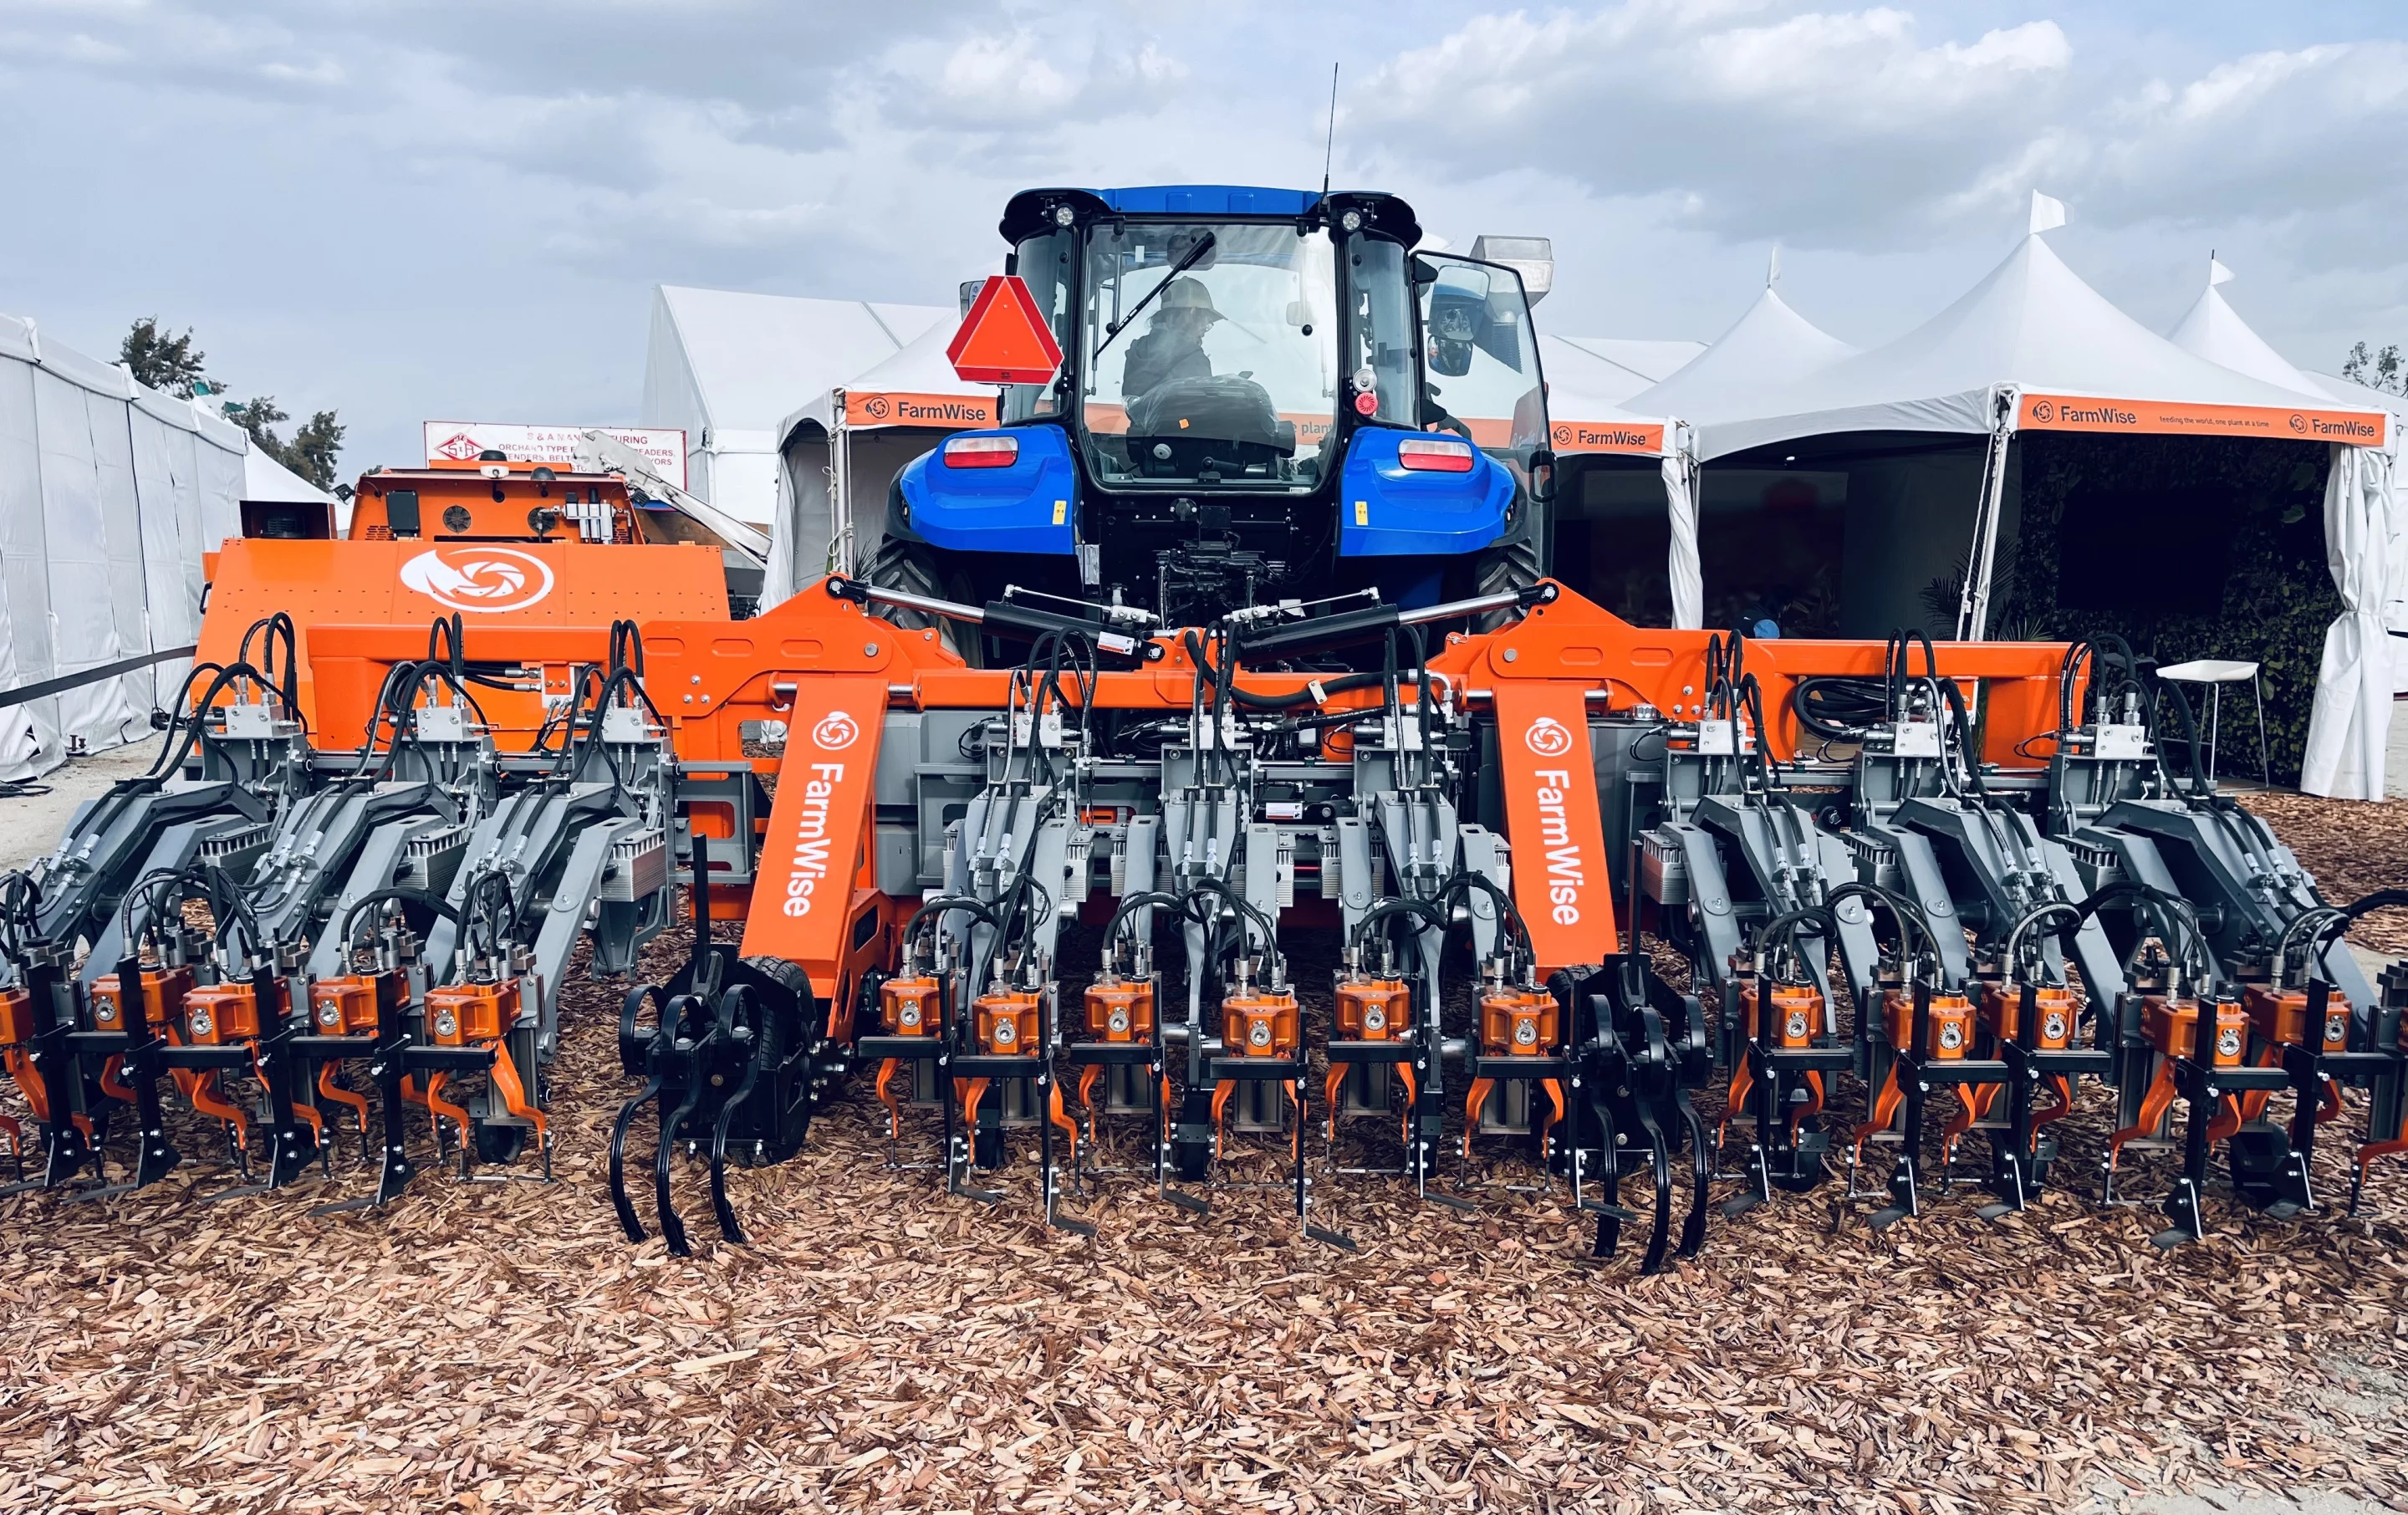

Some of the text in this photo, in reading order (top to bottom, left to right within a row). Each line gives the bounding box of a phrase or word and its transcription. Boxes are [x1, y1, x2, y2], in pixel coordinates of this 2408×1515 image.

[898, 401, 986, 421] FarmWise
[2060, 406, 2137, 424] FarmWise
[2160, 416, 2183, 425] feeding
[2312, 418, 2375, 436] FarmWise
[1579, 430, 1646, 446] FarmWise
[545, 445, 568, 453] TYPE
[783, 763, 844, 917] FarmWise
[1534, 770, 1584, 926] FarmWise
